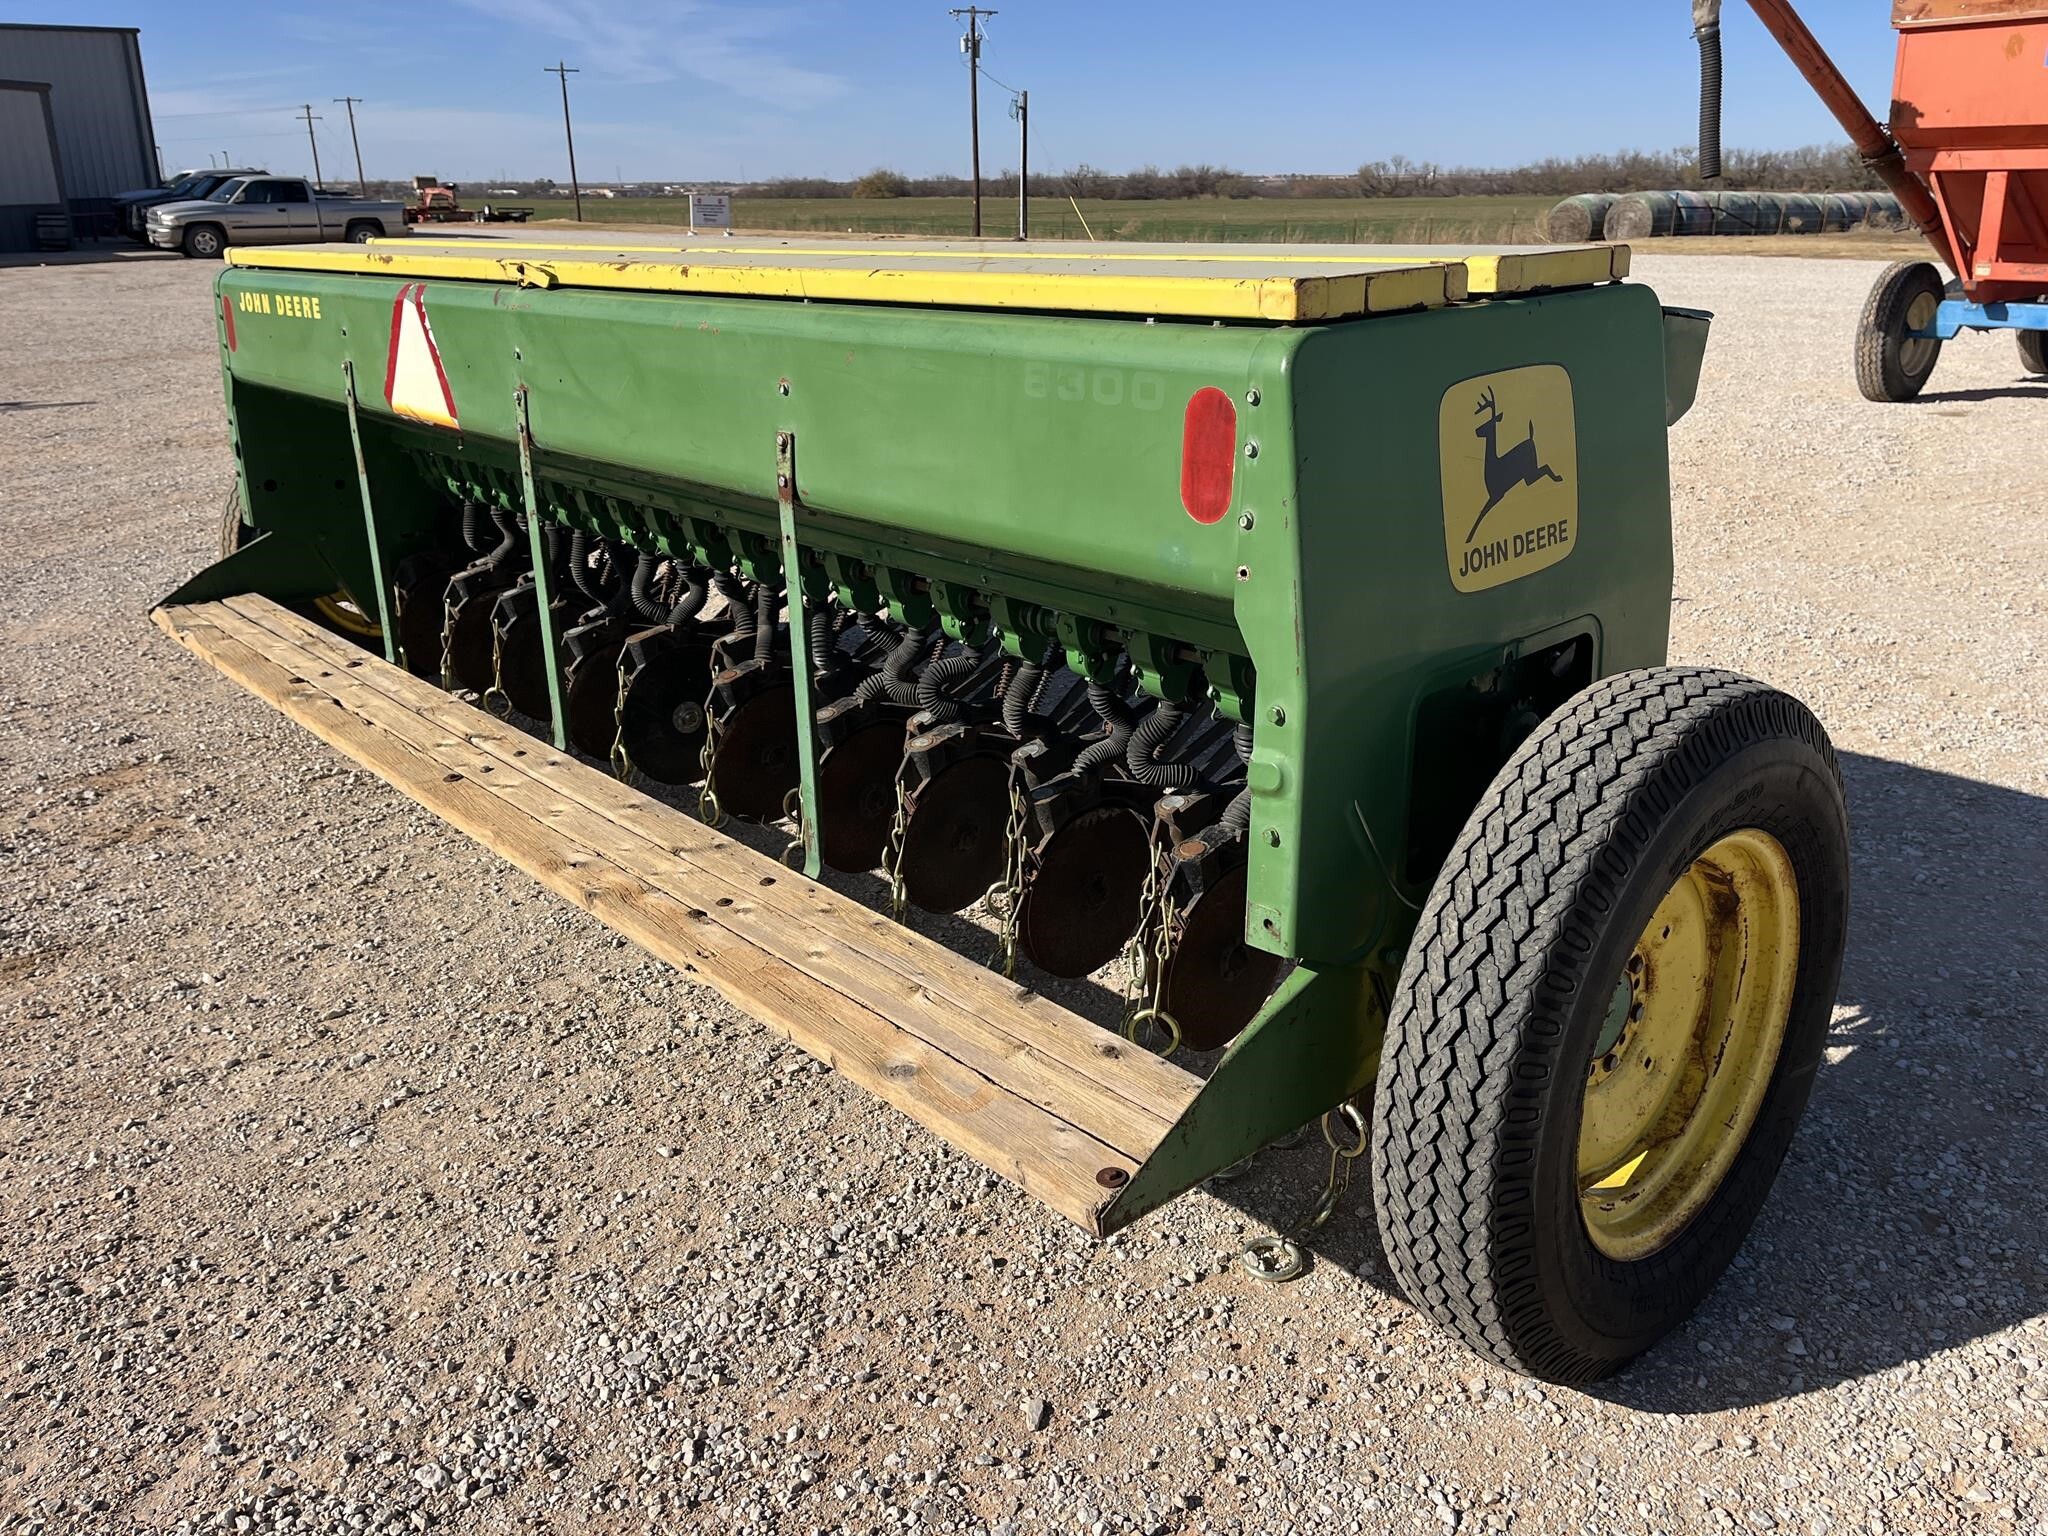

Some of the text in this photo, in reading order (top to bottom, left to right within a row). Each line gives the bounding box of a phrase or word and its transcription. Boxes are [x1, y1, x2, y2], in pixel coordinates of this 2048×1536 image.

[240, 291, 322, 319] JOHN DEERE
[1459, 519, 1569, 577] JOHN DEERE
